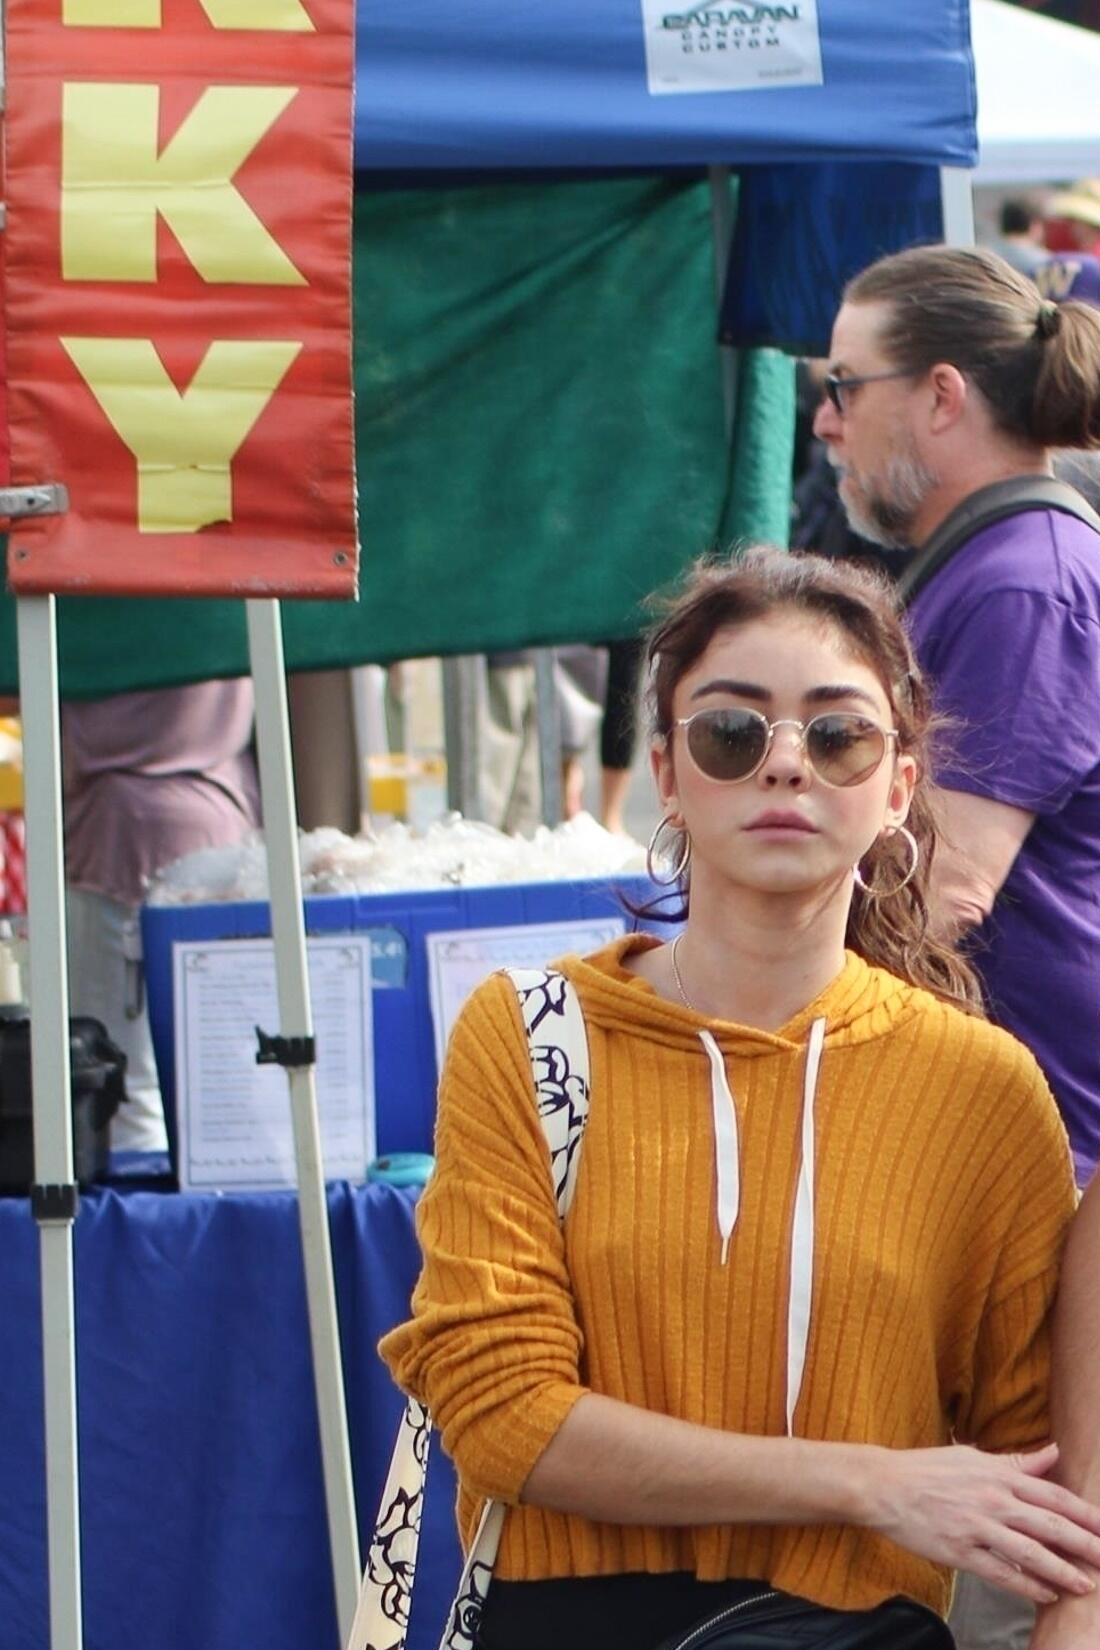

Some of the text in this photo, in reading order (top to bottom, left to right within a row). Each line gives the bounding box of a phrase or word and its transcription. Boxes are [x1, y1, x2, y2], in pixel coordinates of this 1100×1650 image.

[681, 25, 777, 41] CANOPY
[681, 37, 781, 54] CUSTOM
[60, 0, 316, 534] KY
